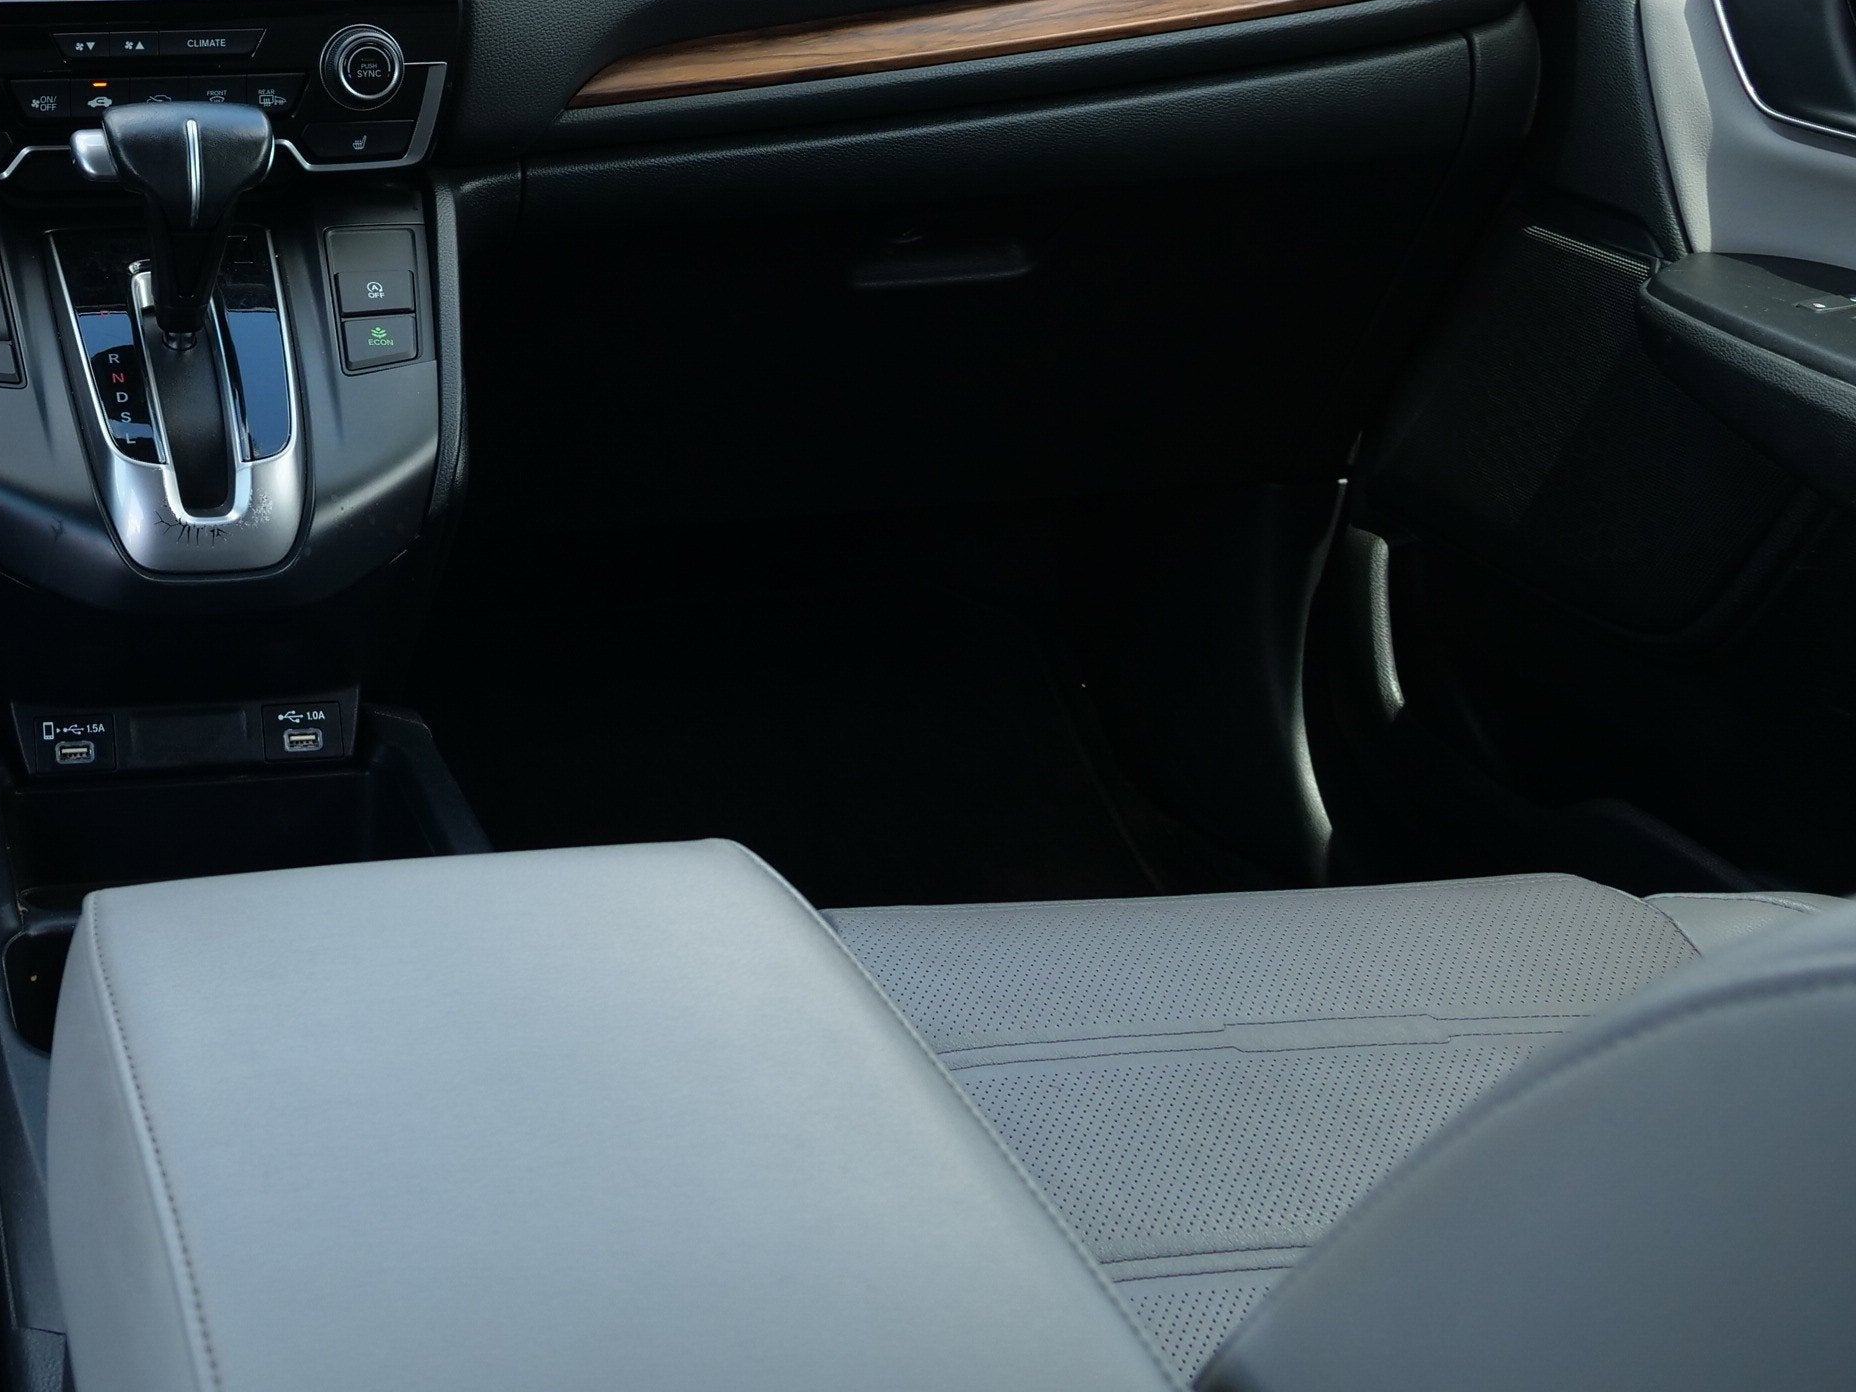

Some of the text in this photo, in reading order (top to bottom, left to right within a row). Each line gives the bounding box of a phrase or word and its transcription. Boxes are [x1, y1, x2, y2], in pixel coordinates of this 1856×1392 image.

[187, 38, 227, 48] CLIMATE
[357, 69, 382, 78] SYNC
[39, 103, 58, 111] OFF
[368, 338, 394, 346] ECON
[108, 353, 120, 364] R
[112, 372, 125, 383] N
[116, 391, 129, 403] D
[120, 411, 132, 423] S
[125, 432, 136, 444] L
[306, 710, 326, 721] 1.0A
[86, 723, 106, 734] 1.5A
